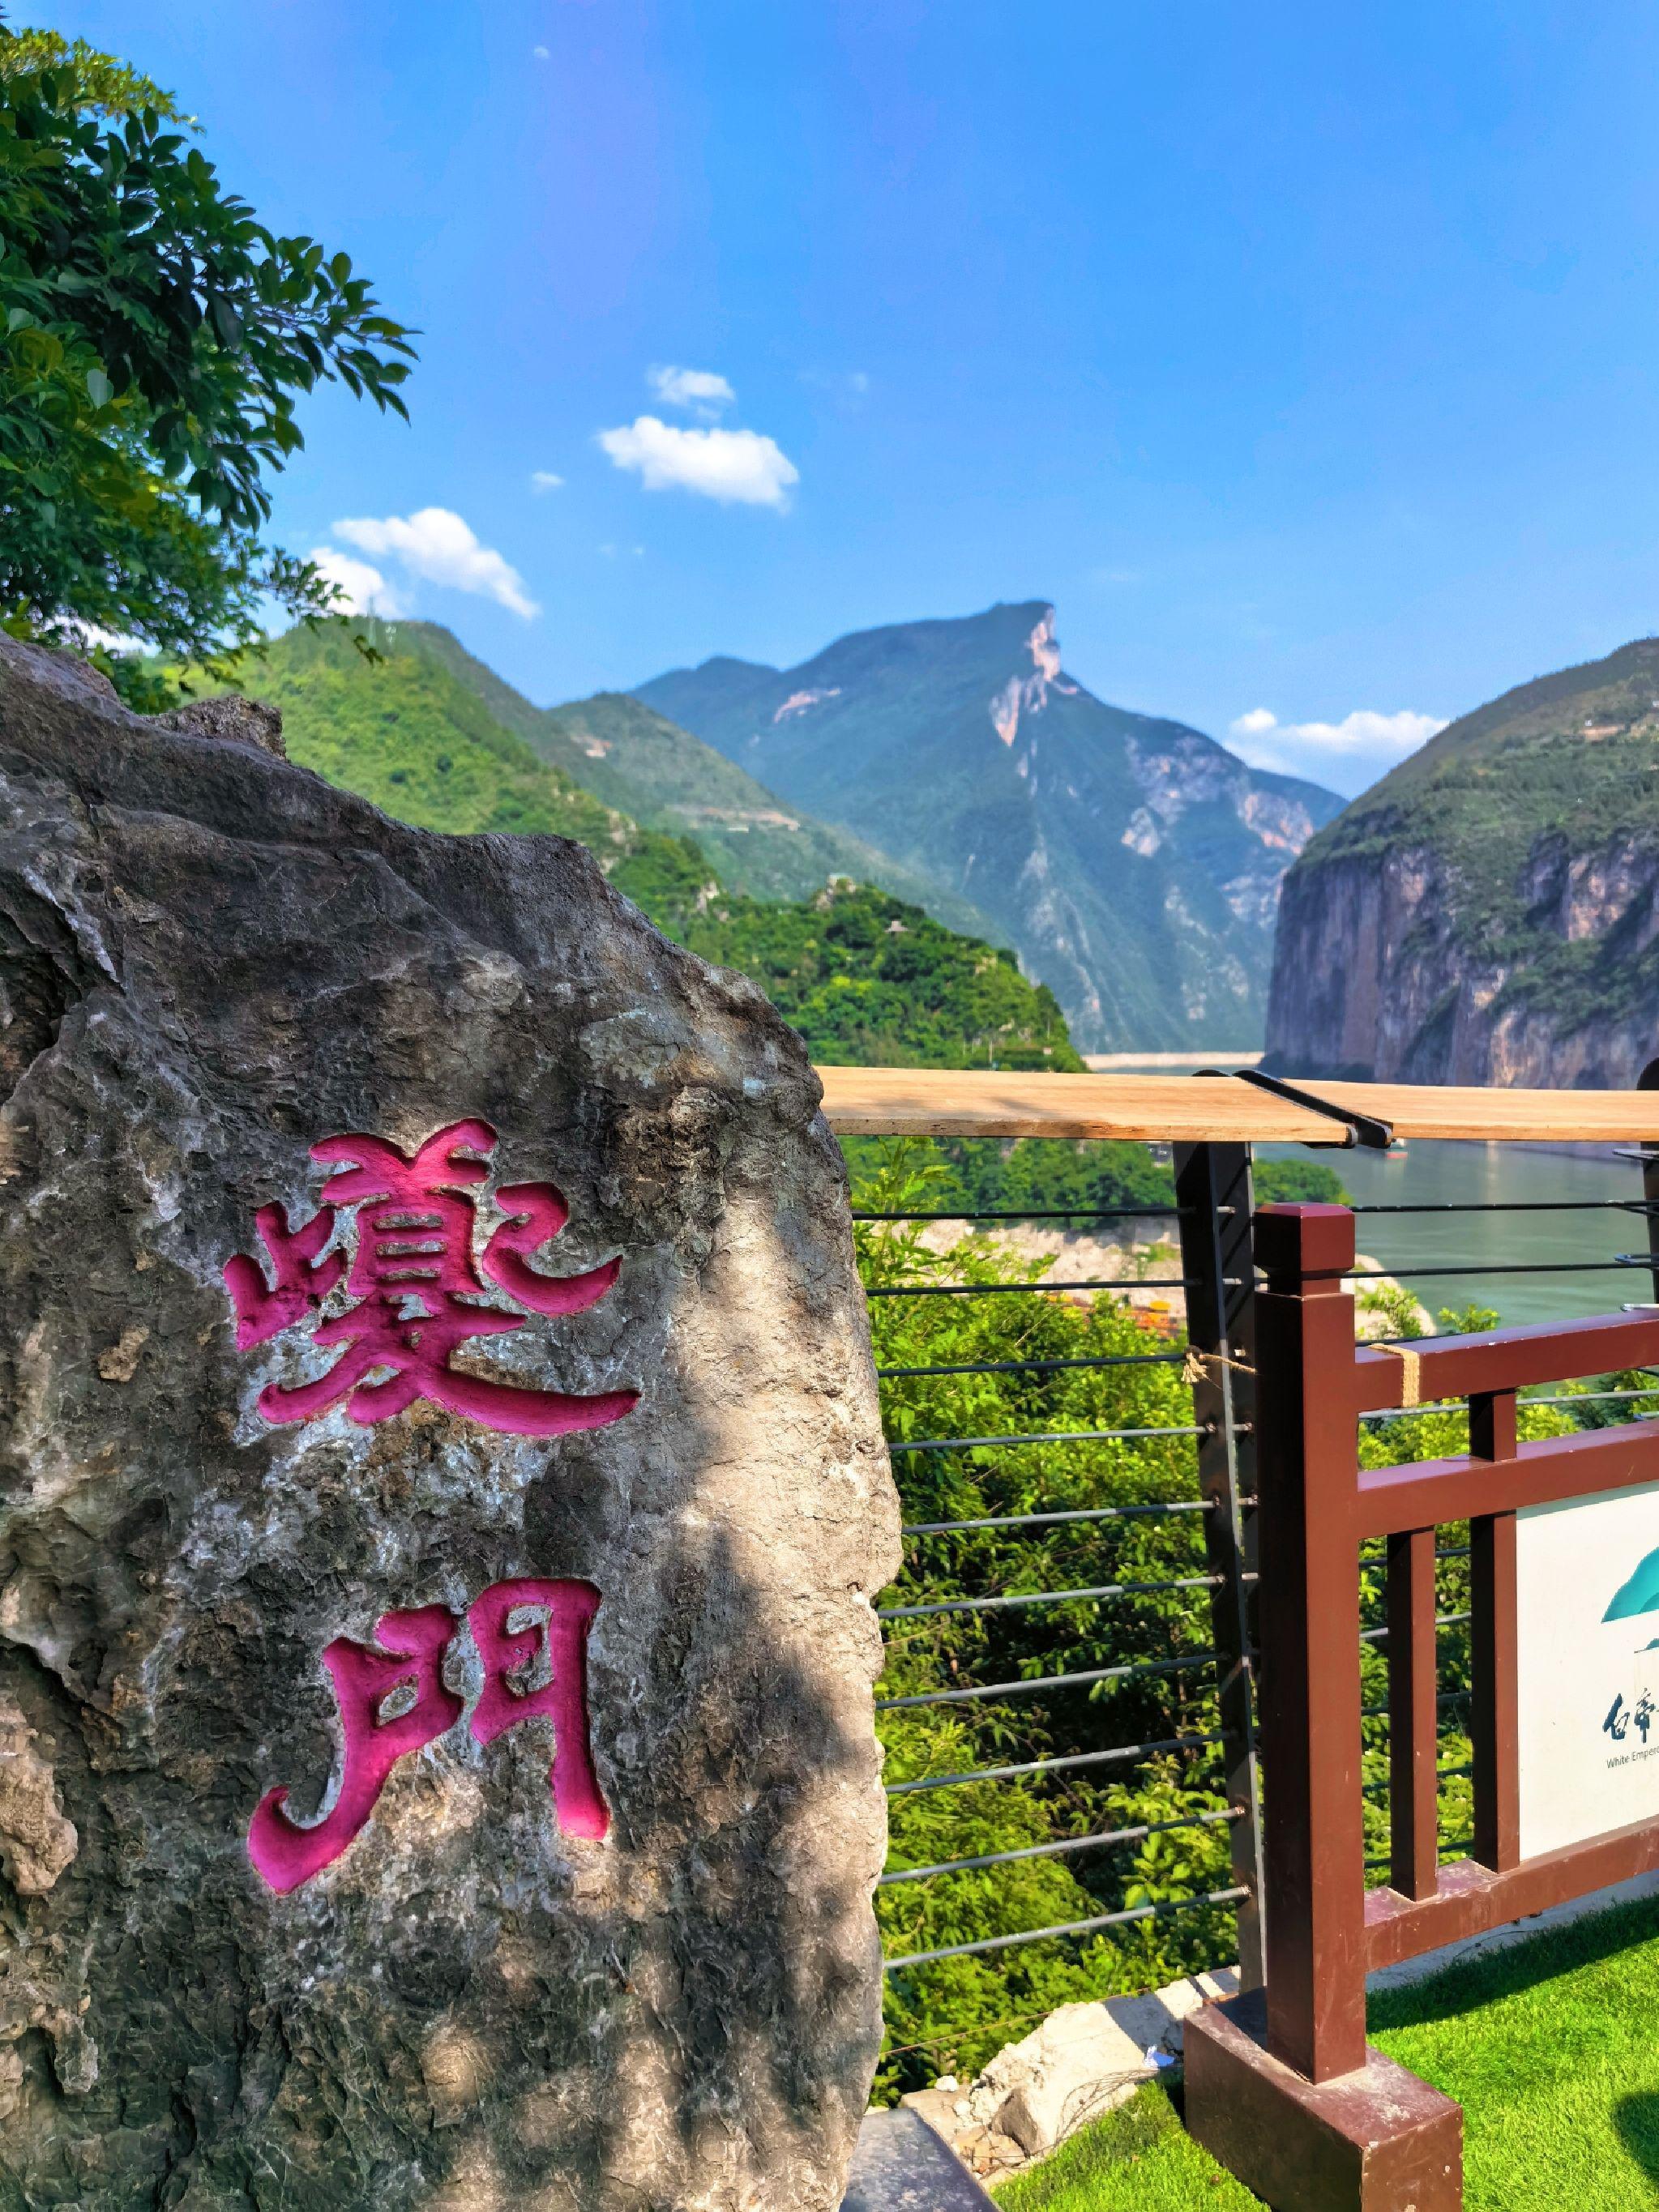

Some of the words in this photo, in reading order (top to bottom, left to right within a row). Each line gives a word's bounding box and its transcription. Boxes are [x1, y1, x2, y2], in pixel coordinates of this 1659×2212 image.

[221, 1118, 641, 1896] 夔門
[1602, 1687, 1659, 1744] 白帝
[1606, 1755, 1630, 1768] White
